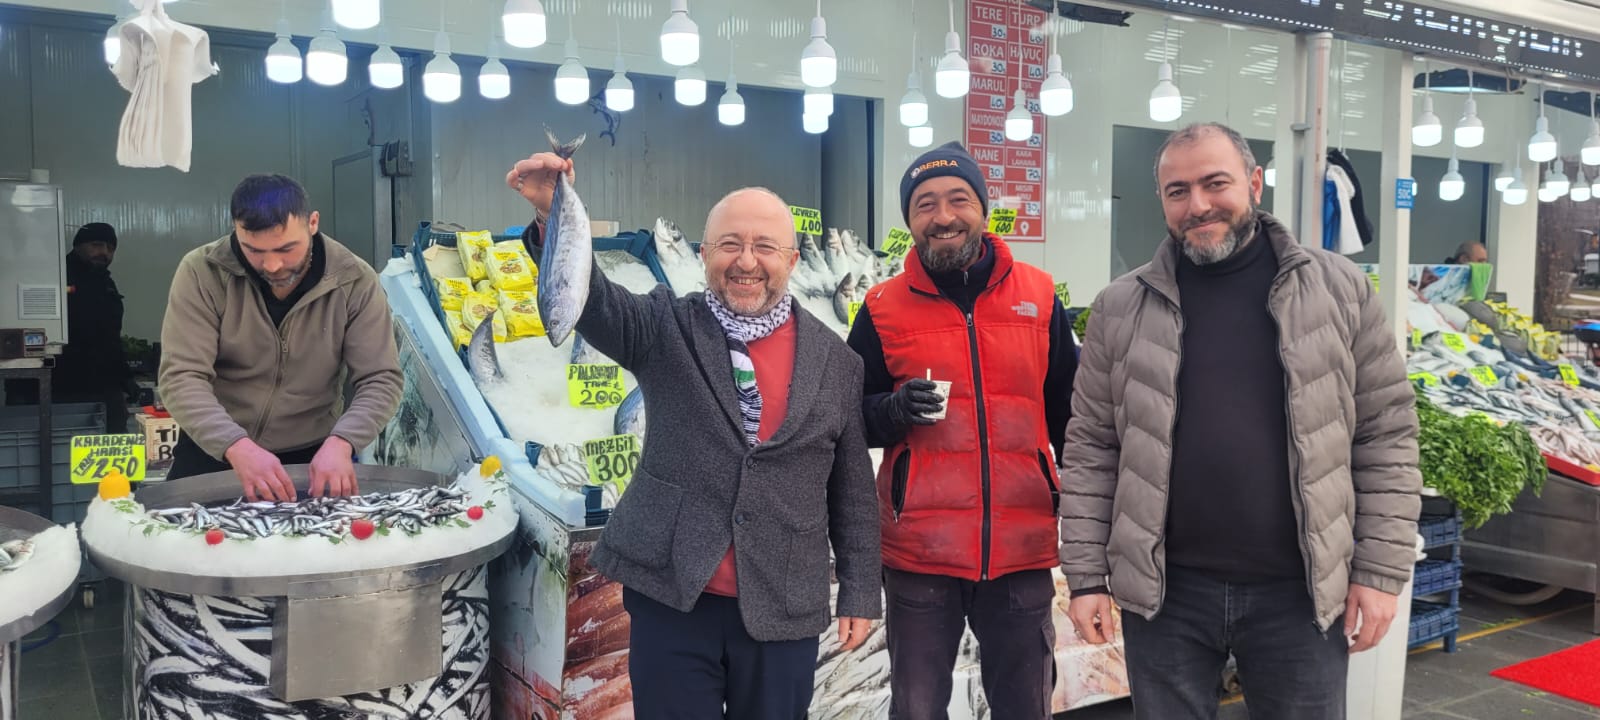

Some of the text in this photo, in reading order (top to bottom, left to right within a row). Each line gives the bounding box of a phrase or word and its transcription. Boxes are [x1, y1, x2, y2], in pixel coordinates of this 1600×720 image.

[976, 6, 1003, 21] TERE
[1012, 12, 1041, 26] TURP
[973, 43, 1004, 58] ROKA
[1010, 46, 1042, 62] HAVUÇ
[972, 77, 1005, 92] MARUL
[974, 149, 999, 161] NANE
[995, 221, 1011, 233] 600
[580, 389, 623, 405] 200
[91, 456, 138, 478] 250
[596, 452, 641, 481] 300
